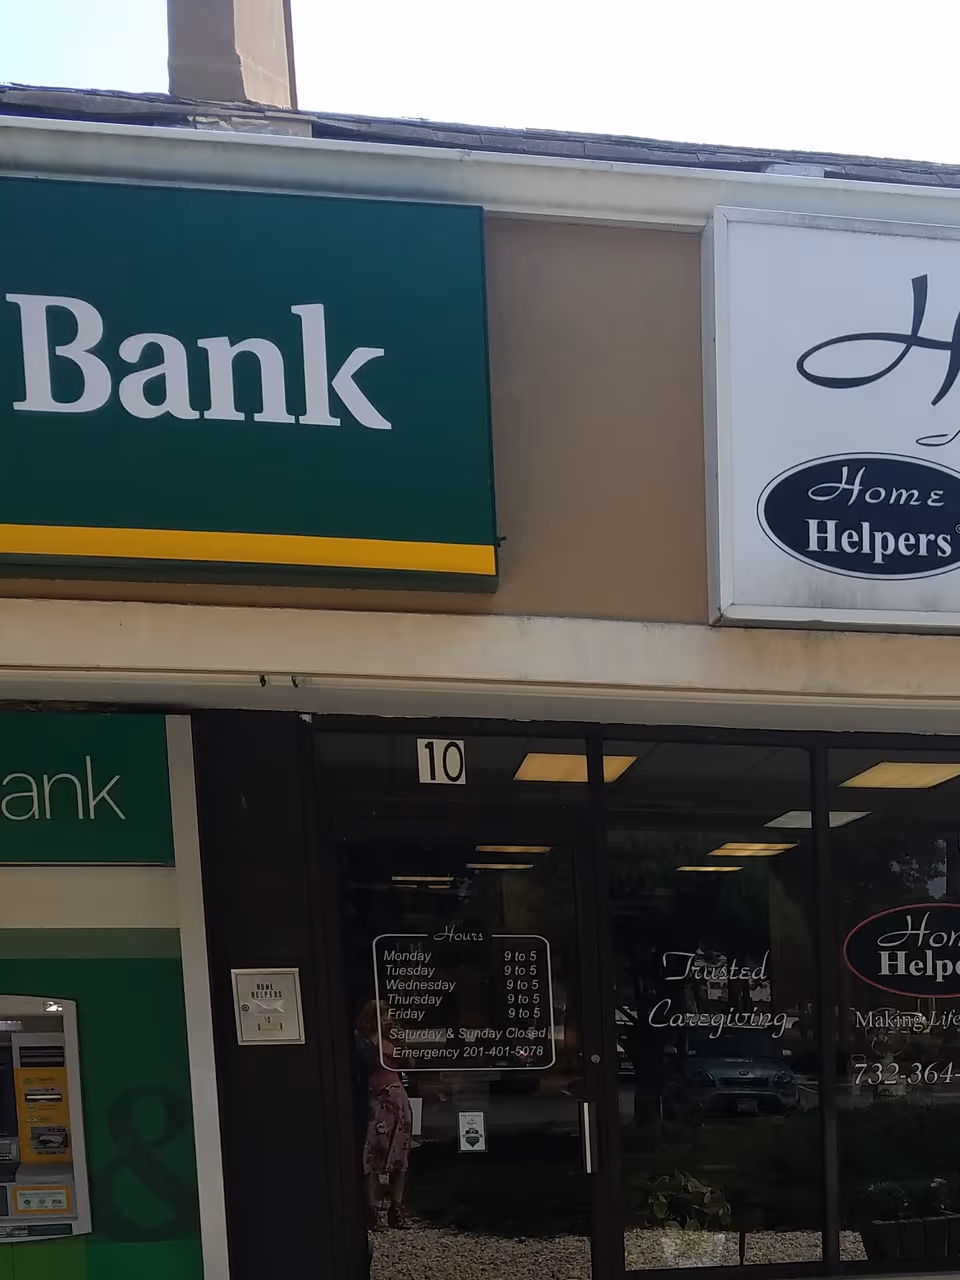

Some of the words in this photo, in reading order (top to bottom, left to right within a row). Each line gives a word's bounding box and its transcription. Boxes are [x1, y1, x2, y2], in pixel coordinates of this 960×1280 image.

[4, 292, 392, 430] Bank
[807, 466, 945, 506] Home
[424, 741, 464, 782] 10
[433, 925, 484, 942] Hours
[383, 950, 432, 963] Monday
[504, 951, 512, 961] 9
[515, 951, 526, 961] to
[529, 951, 537, 961] 5
[385, 965, 435, 978] Tuesday
[504, 965, 512, 976] 9
[515, 965, 526, 976] to
[529, 965, 537, 976] 5
[662, 950, 770, 980] Trusted
[386, 979, 456, 992] Wednesday
[506, 980, 514, 990] 9
[517, 980, 528, 990] to
[532, 980, 540, 990] 5
[387, 994, 443, 1006] Thursday
[507, 994, 515, 1004] 9
[518, 994, 529, 1004] to
[532, 994, 540, 1004] 5
[387, 1008, 425, 1021] Friday
[508, 1008, 516, 1018] 9
[519, 1008, 530, 1018] to
[533, 1008, 541, 1018] 5
[648, 998, 787, 1039] Caregiving
[855, 1010, 923, 1032] Making
[929, 1009, 960, 1029] Life
[389, 1028, 442, 1040] Saturday
[446, 1028, 454, 1038] &
[458, 1028, 502, 1040] Sunday
[506, 1028, 546, 1039] Closed
[393, 1047, 460, 1060] Emergency
[463, 1046, 544, 1058] 201-401-5078
